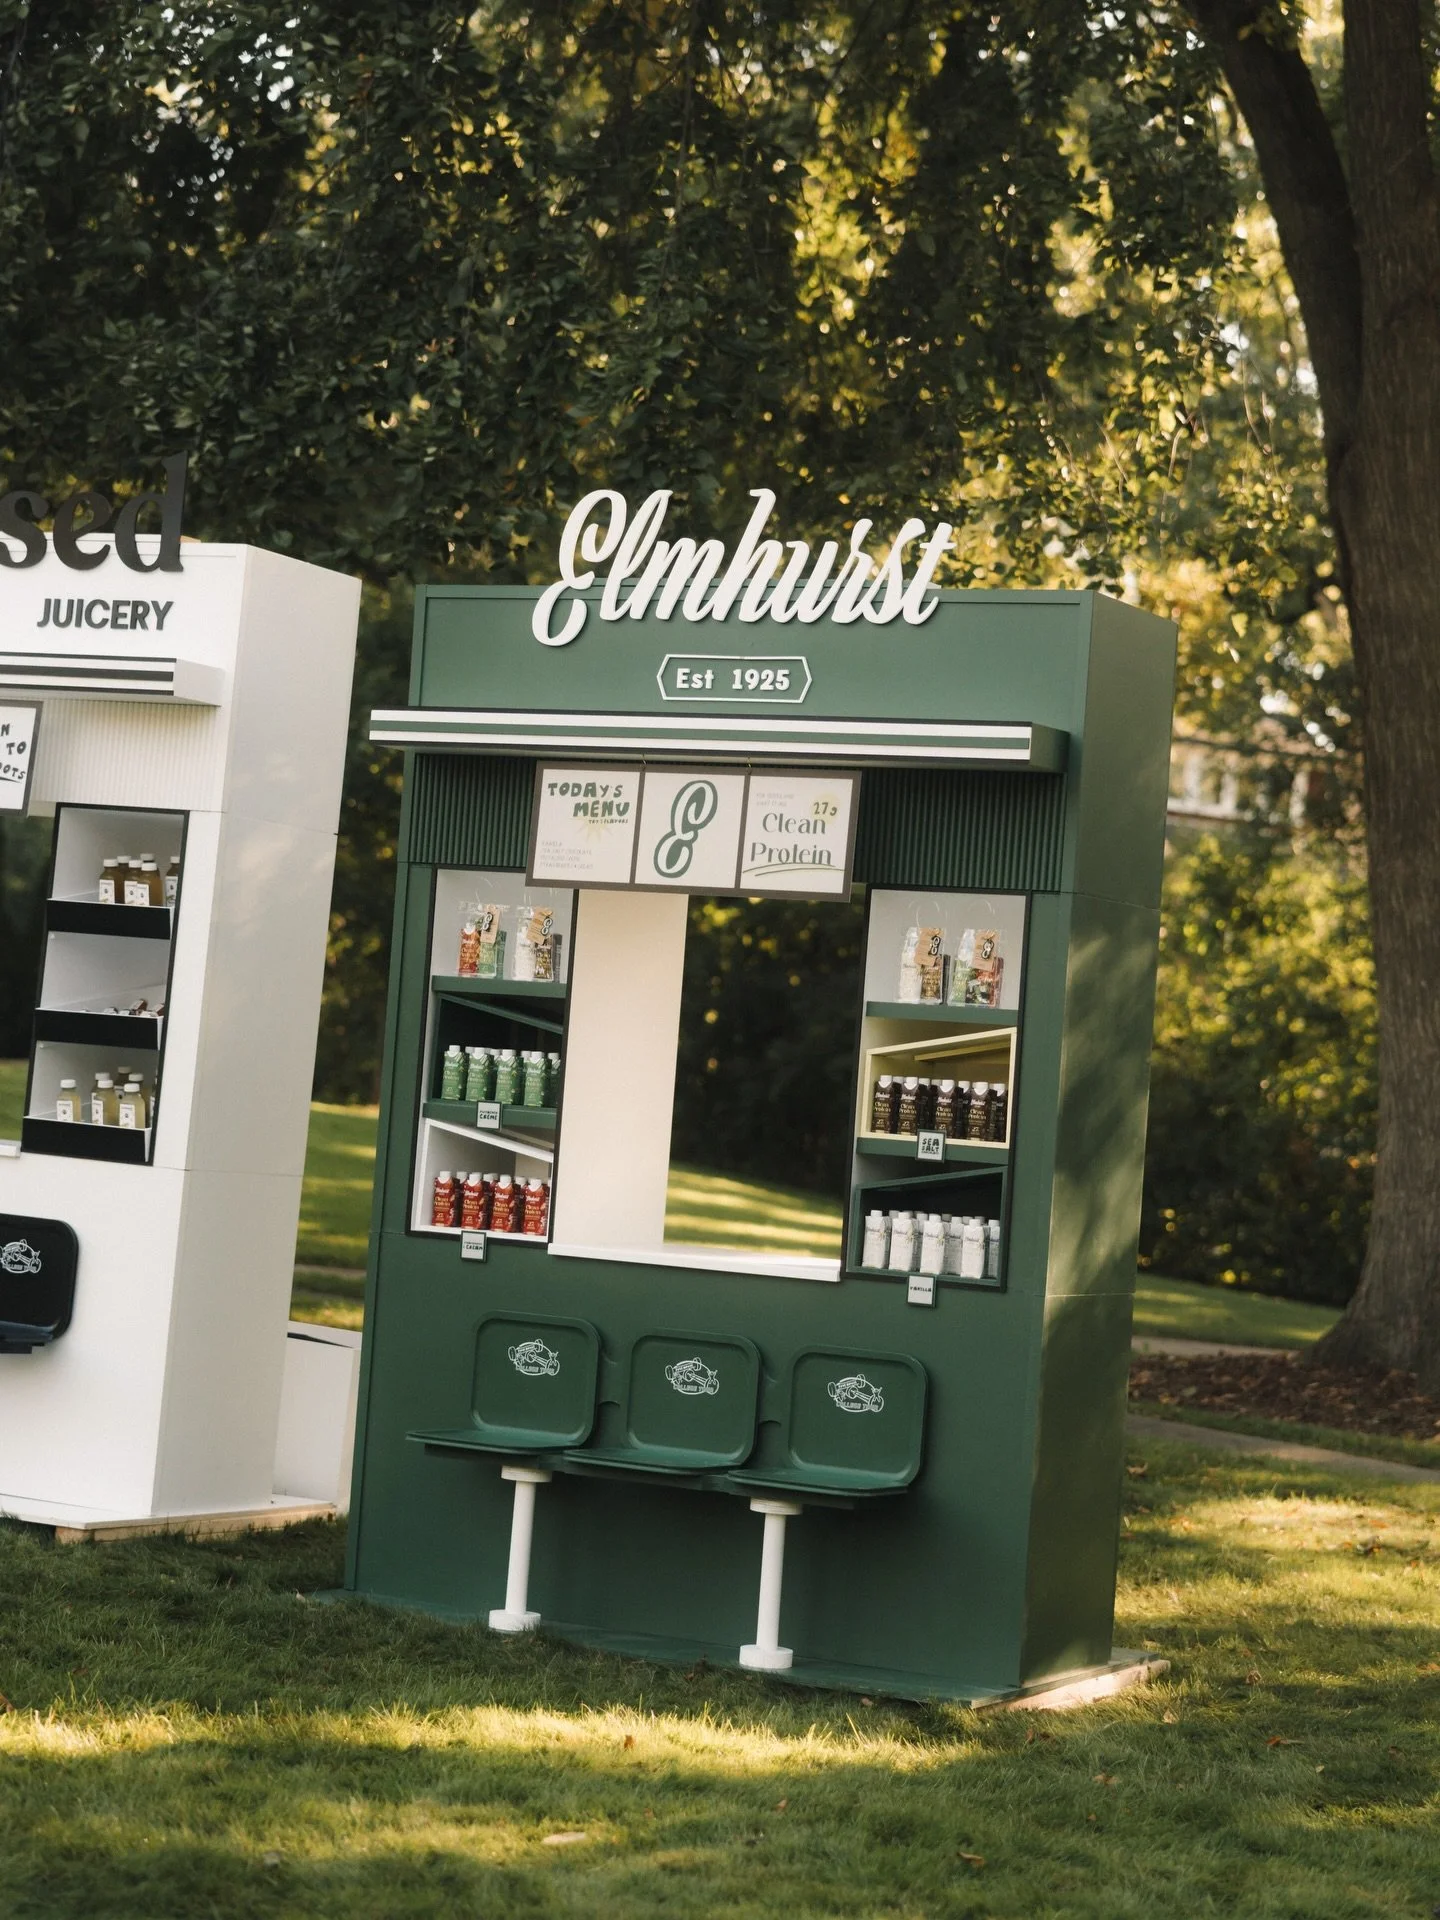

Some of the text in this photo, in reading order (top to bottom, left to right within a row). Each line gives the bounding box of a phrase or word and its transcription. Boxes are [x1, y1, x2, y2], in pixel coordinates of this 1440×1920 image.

[532, 488, 956, 646] Elmhurst
[37, 598, 174, 630] JUICERY
[676, 668, 790, 690] Est 1925
[6, 741, 26, 755] TO
[0, 762, 26, 779] OTS
[573, 800, 630, 817] MENU
[762, 812, 826, 834] Clean
[750, 842, 832, 864] Protein
[922, 1138, 940, 1146] SEA
